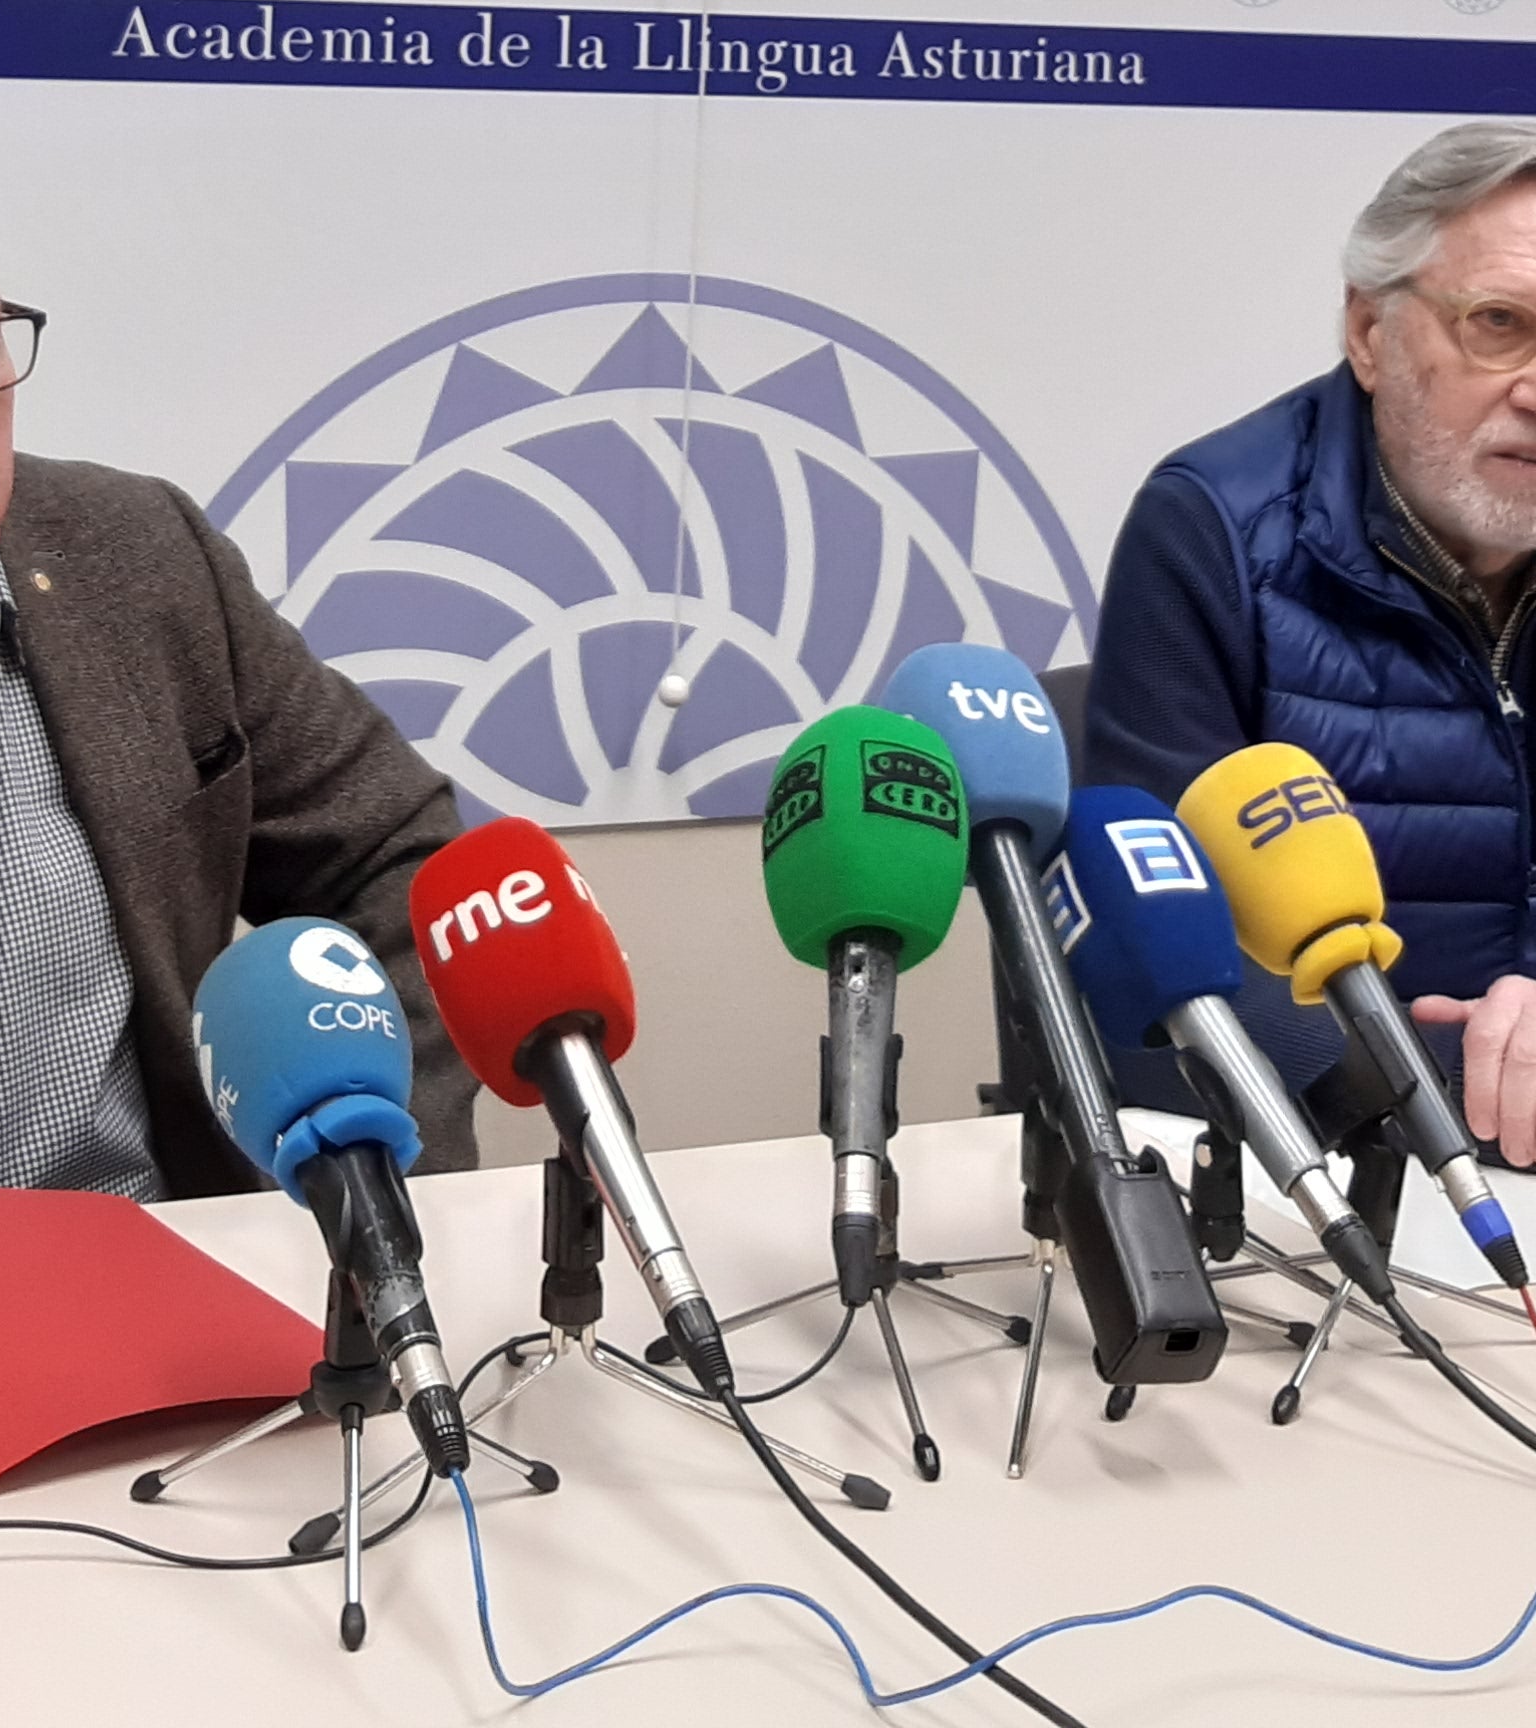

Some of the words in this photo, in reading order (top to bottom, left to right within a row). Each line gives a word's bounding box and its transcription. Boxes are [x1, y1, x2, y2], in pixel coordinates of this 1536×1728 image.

[111, 5, 434, 67] Academia
[458, 11, 531, 69] de
[557, 14, 608, 71] la
[633, 19, 857, 92] Llingua
[879, 30, 1146, 86] Asturiana
[948, 681, 1050, 734] tve
[884, 783, 954, 817] CERO
[429, 870, 553, 963] rne
[308, 1001, 397, 1040] COPE
